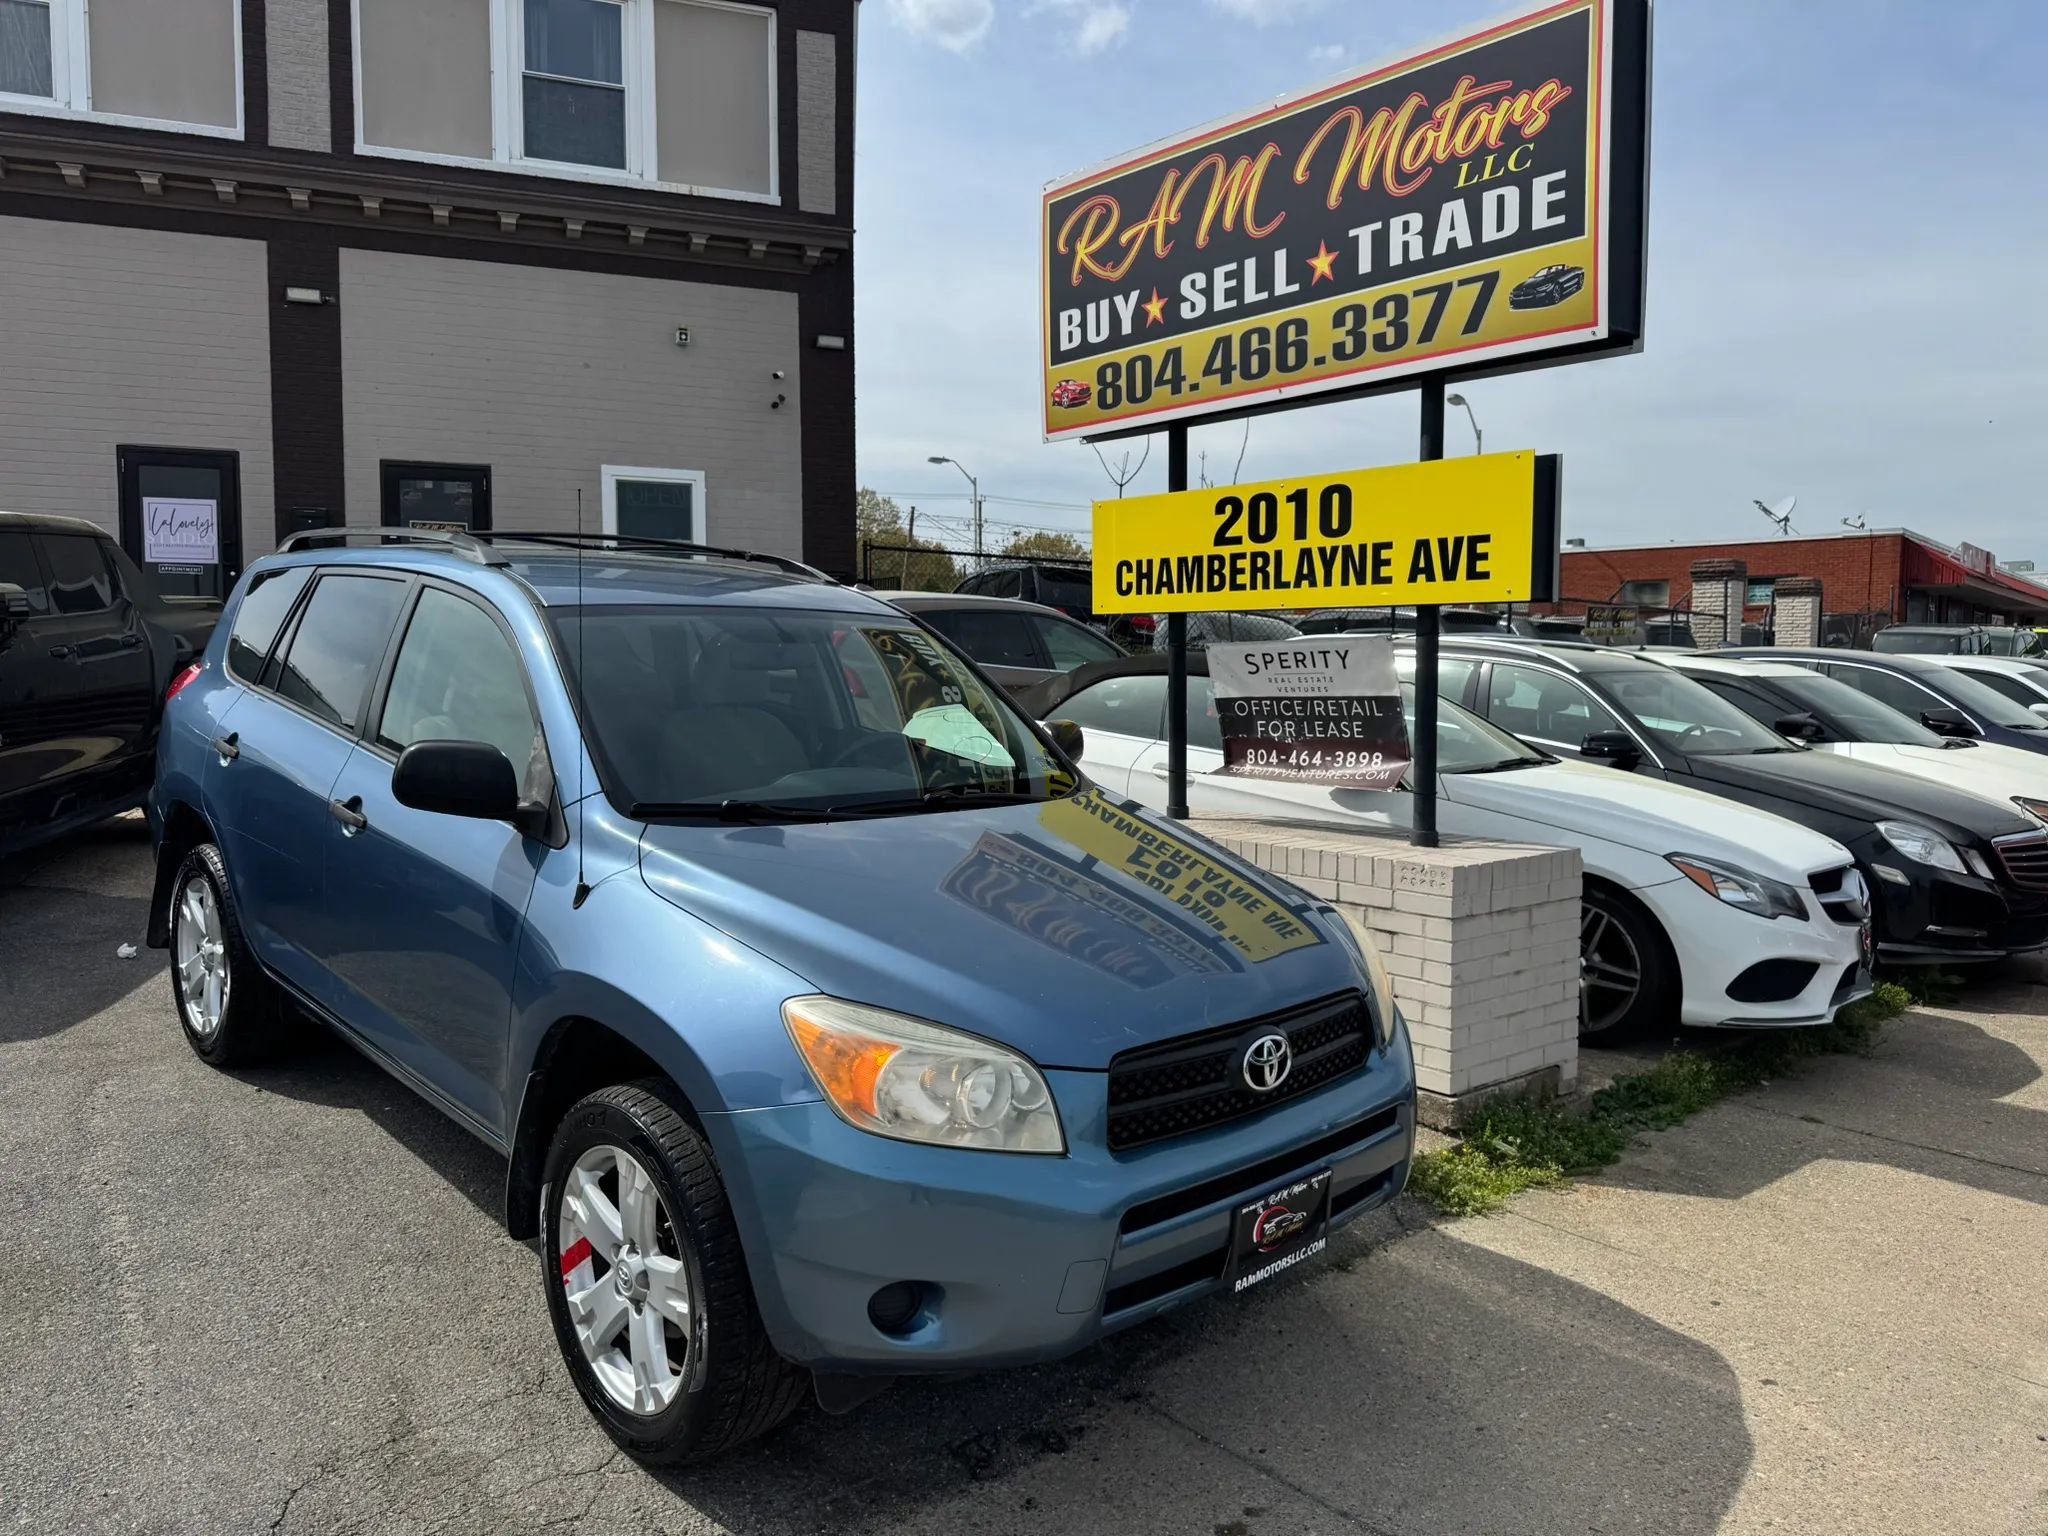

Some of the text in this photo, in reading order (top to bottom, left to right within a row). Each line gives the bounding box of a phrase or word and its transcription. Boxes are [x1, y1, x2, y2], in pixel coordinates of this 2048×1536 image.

[1058, 75, 1571, 286] RAM Motors
[1453, 142, 1535, 191] LLC
[1059, 169, 1567, 352] BUY SELL TRADE
[1096, 271, 1500, 411] 804.466.3377
[1213, 483, 1352, 547] 2010
[1116, 534, 1491, 597] CHAMBERLAYNE AVE
[1244, 650, 1349, 675] SPERITY
[1268, 676, 1334, 684] REAL ESTATE
[1234, 700, 1383, 716] OFFICE/RETAIL
[1257, 720, 1364, 738] FOR LEASE
[1229, 764, 1390, 780] SPERITYVENTURES.COM
[1247, 748, 1383, 768] 804-464-3898
[1234, 1237, 1326, 1293] RAMMOTORSLLC.COM
